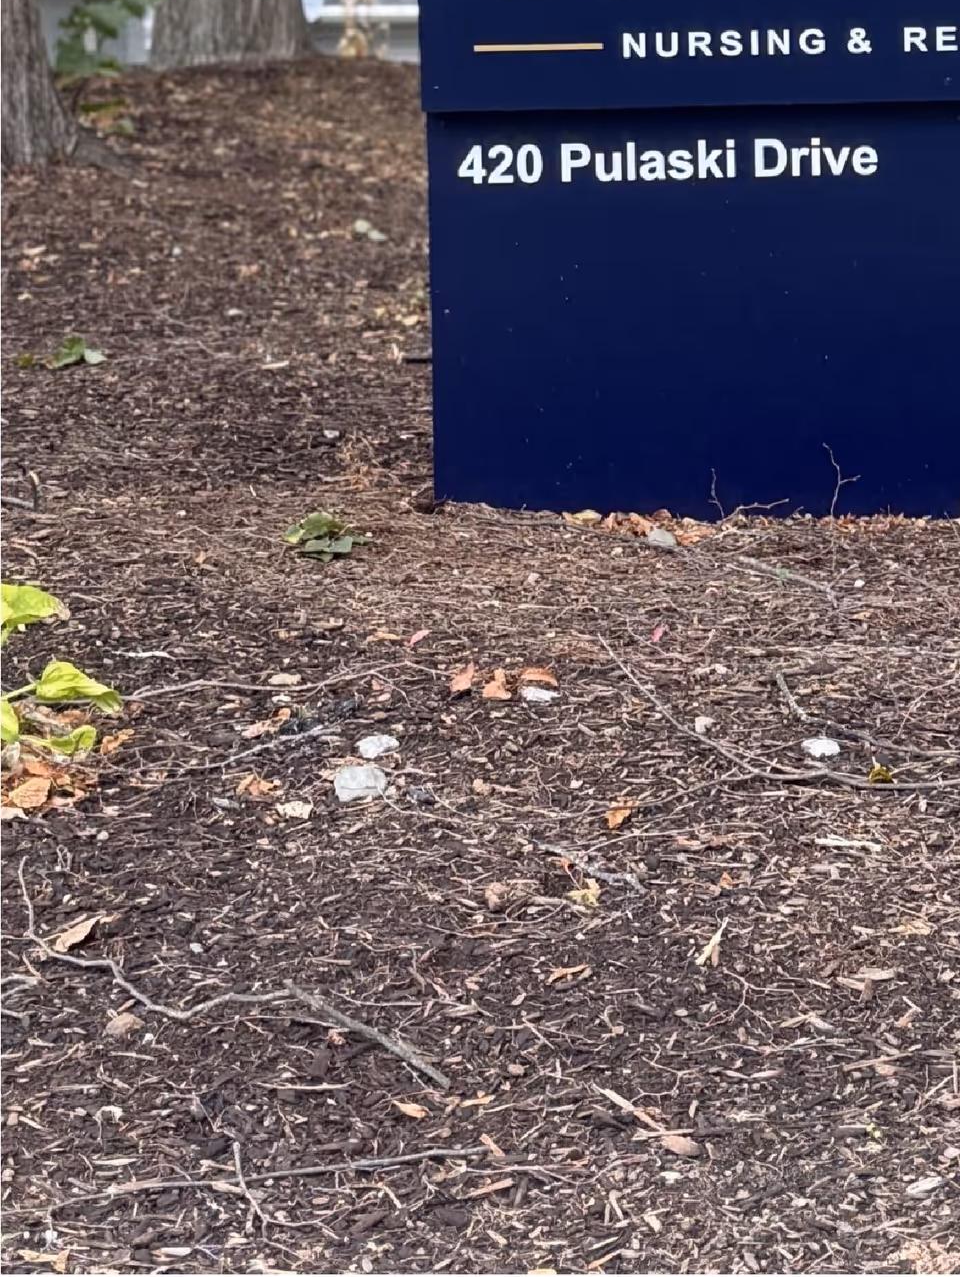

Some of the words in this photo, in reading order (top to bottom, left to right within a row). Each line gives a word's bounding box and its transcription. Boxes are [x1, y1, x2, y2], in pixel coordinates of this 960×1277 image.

[622, 28, 826, 59] NURSING
[847, 27, 873, 54] &
[457, 143, 544, 185] 420
[560, 138, 737, 183] Pulaski
[754, 137, 879, 178] Drive
